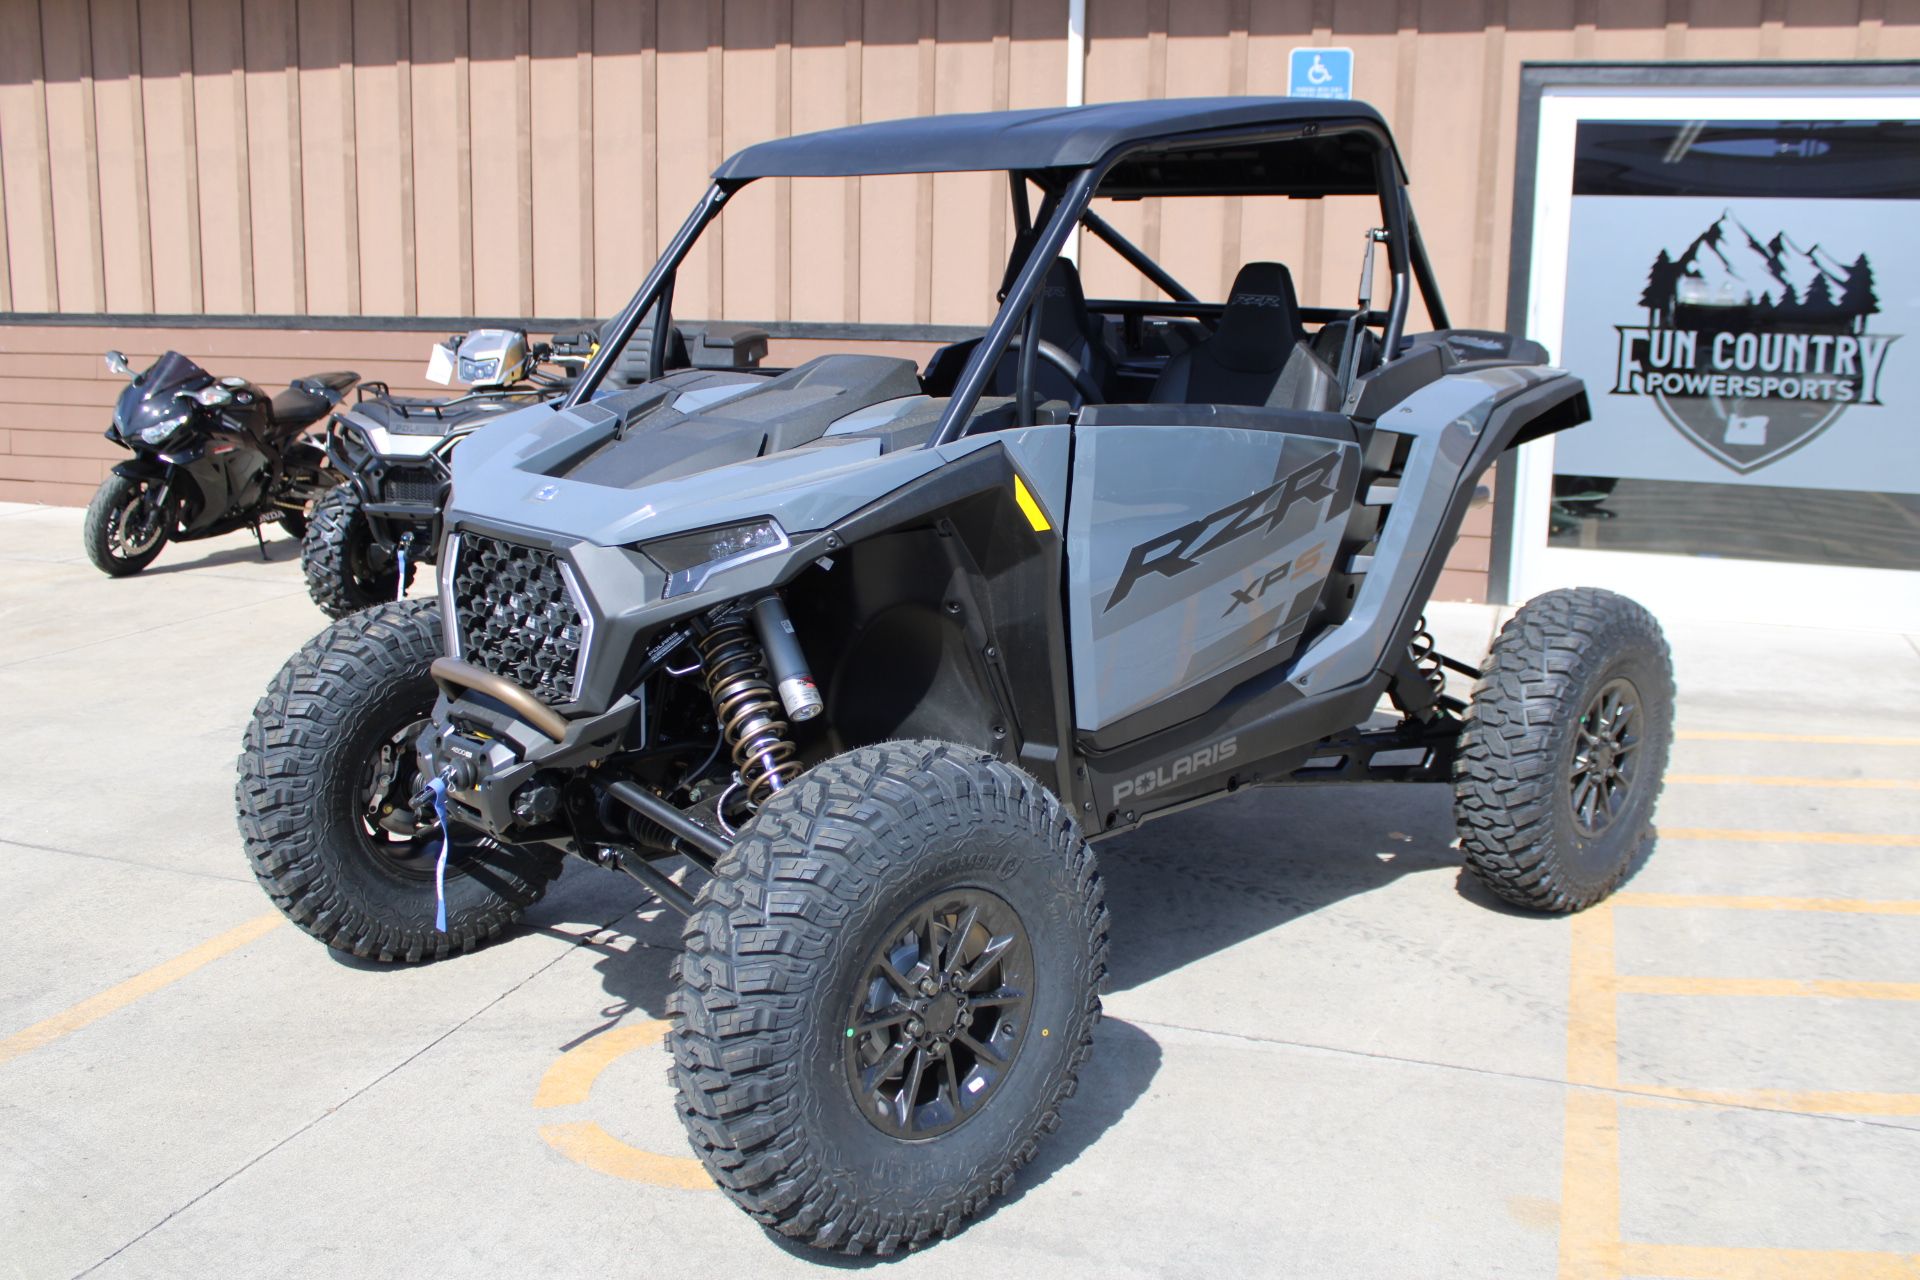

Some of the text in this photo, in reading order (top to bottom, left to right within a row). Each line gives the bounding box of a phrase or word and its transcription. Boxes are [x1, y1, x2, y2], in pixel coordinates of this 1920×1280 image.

[1609, 325, 1904, 405] FUN COUNTRY
[1646, 372, 1853, 402] POWERSPORTS
[1103, 451, 1341, 614] RZR
[1113, 737, 1238, 806] POLARIS
